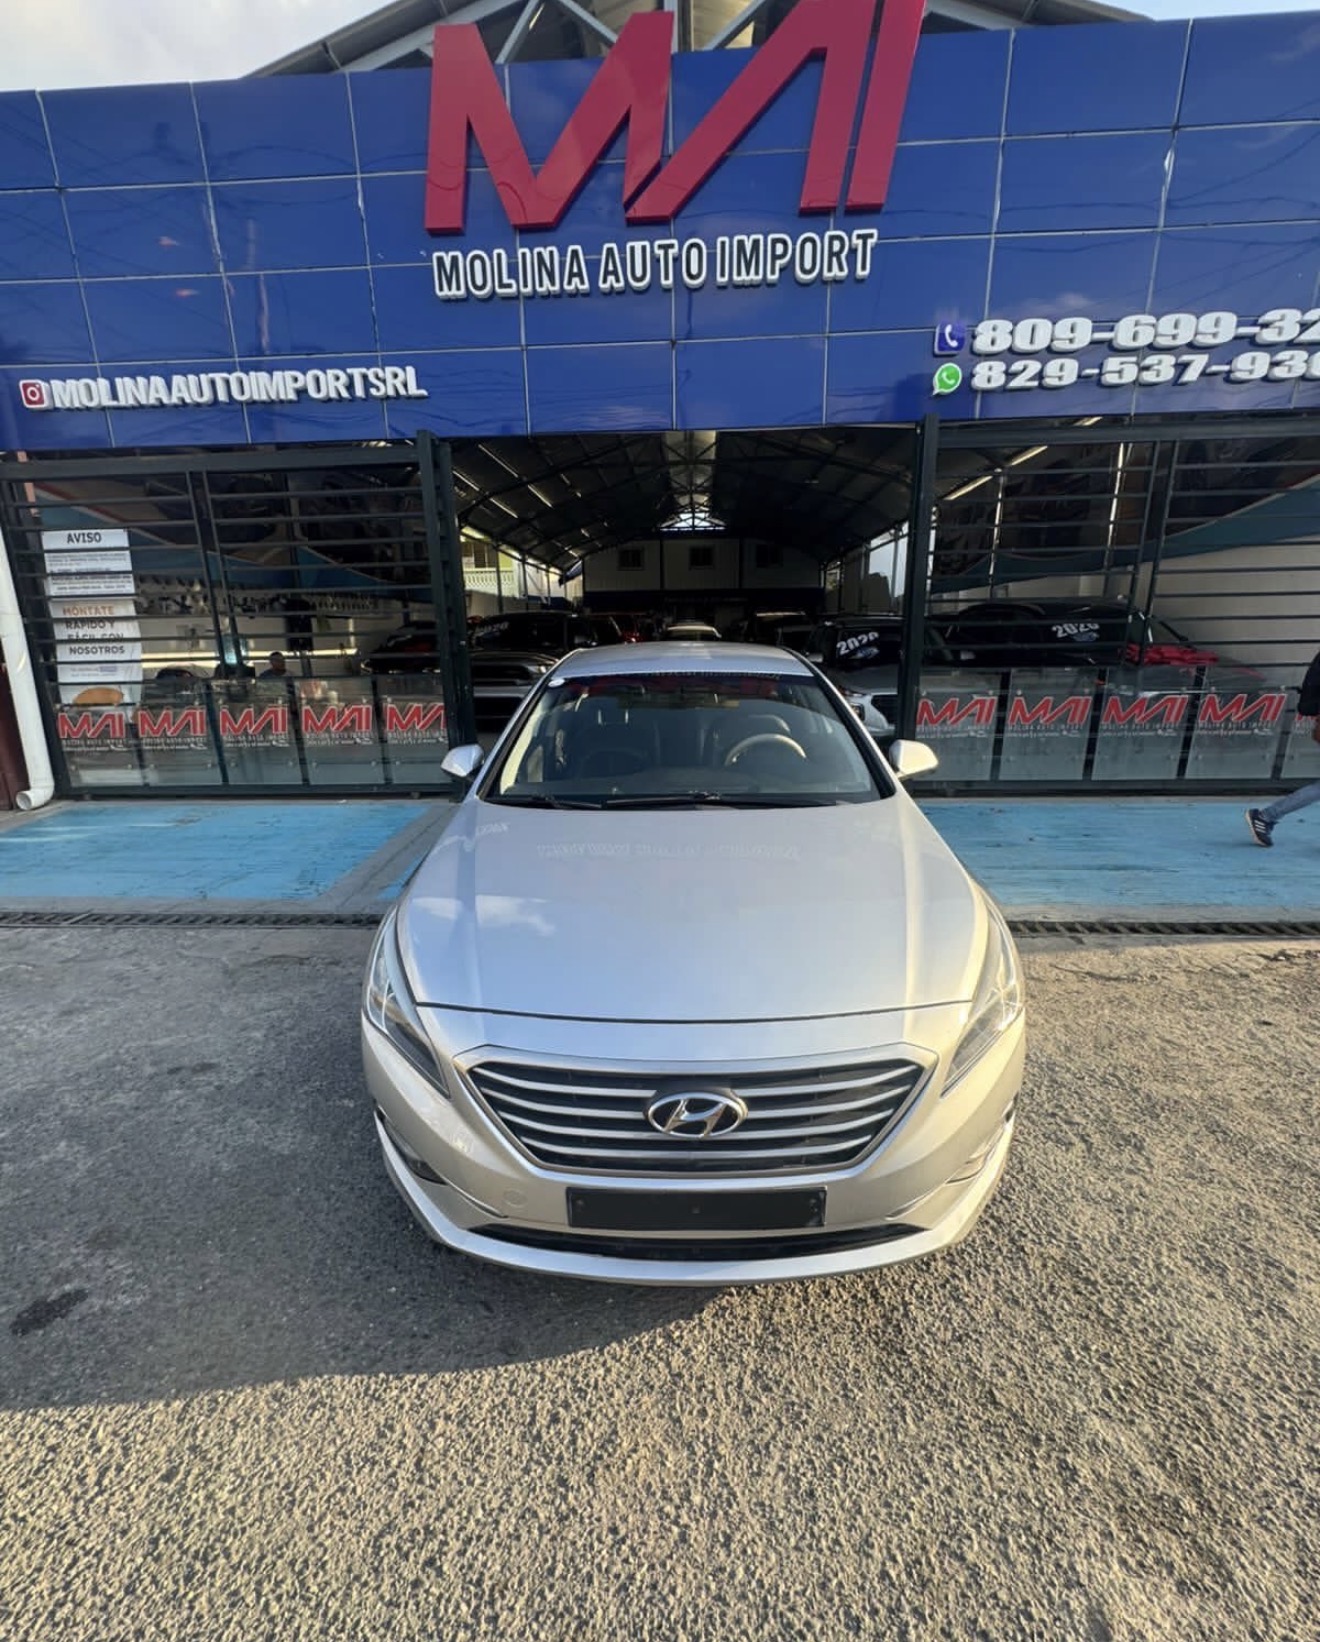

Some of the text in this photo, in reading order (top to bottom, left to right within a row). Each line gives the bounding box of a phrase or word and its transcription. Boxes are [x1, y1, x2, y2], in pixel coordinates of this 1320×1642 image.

[433, 228, 877, 299] MOLINA AUTO IMPORT
[48, 366, 428, 409] MOLINAAUTOIMPORTSRL
[67, 532, 102, 544] AVISO
[69, 645, 125, 655] NOSOTROS
